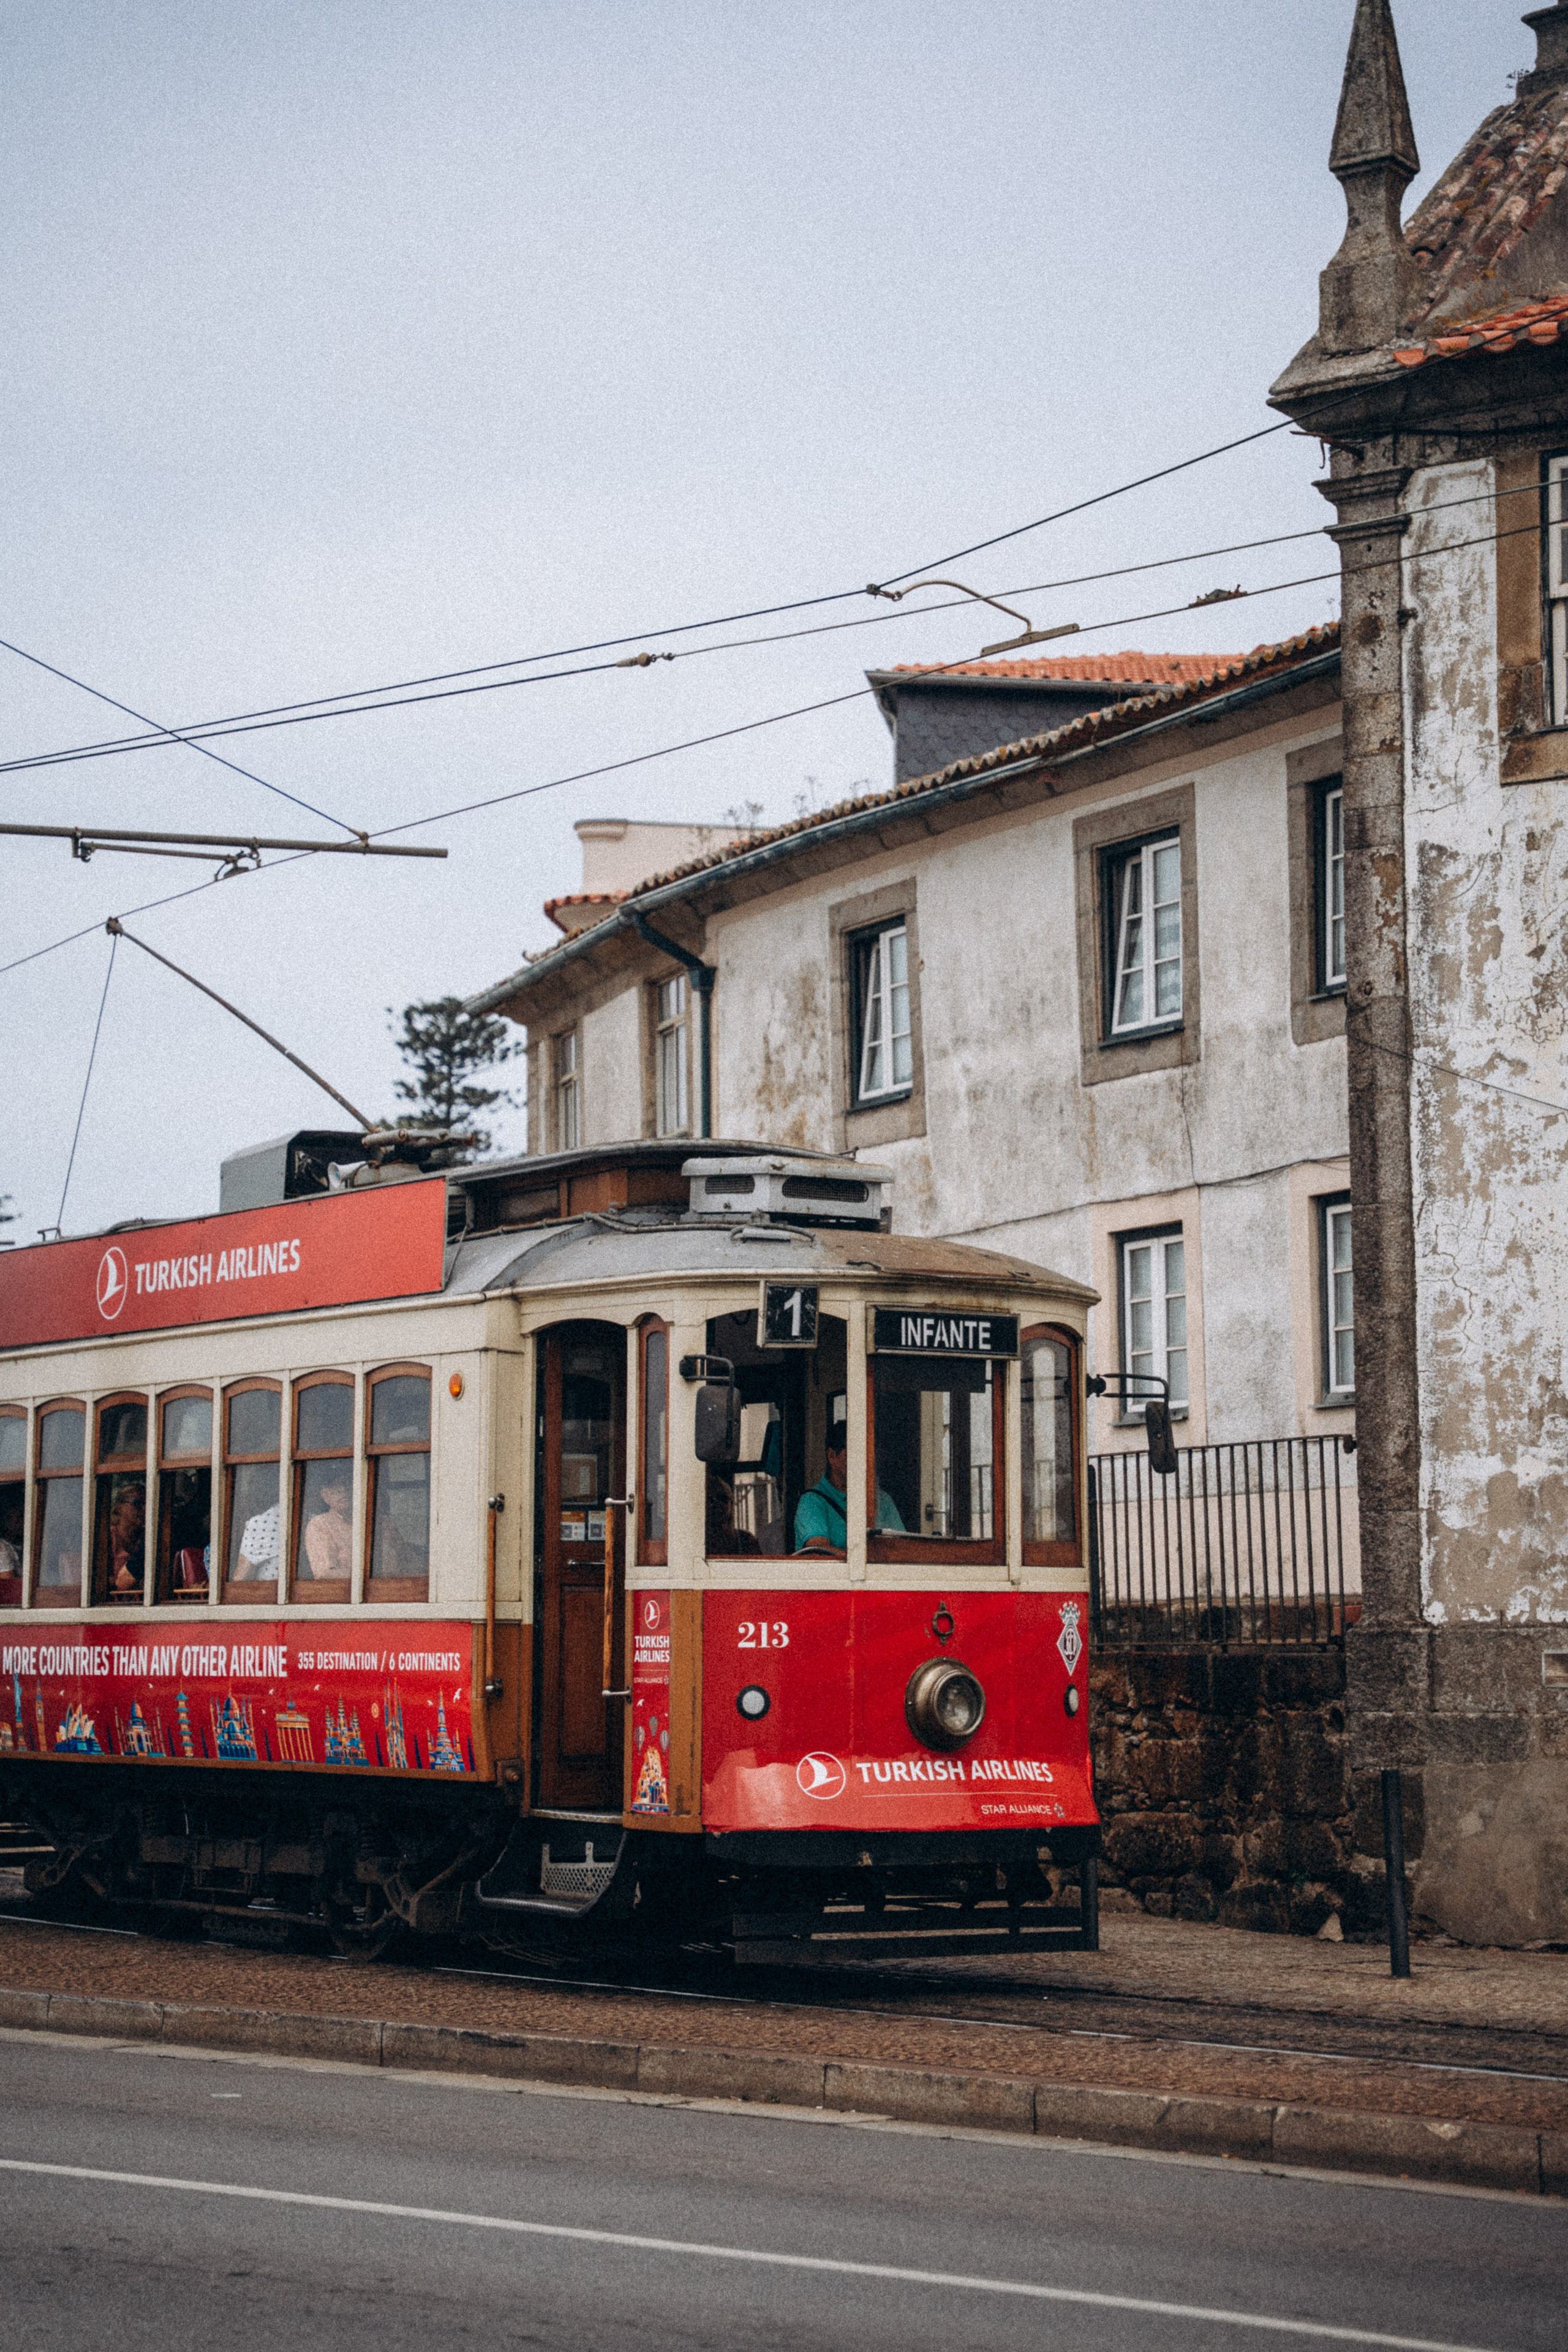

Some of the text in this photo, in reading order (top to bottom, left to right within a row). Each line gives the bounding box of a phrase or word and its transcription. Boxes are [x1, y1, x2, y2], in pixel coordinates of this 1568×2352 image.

[135, 1238, 301, 1294] TURKISH AIRLINES
[783, 1291, 801, 1336] 1
[900, 1317, 991, 1350] INFANTE
[635, 1635, 670, 1648] TURKISH
[737, 1621, 790, 1648] 213
[2, 1645, 288, 1677] MORE COUNTRIES THAN ANY OTHER AIRLINE
[298, 1652, 314, 1670] 355
[317, 1652, 377, 1670] DESTINATION
[389, 1653, 395, 1670] 6
[398, 1653, 460, 1671] CONTINENTS
[634, 1650, 670, 1663] AIRLINES
[856, 1760, 1054, 1783] TURKISH AIRLINES
[981, 1805, 1052, 1815] STAR ALLIANCE
